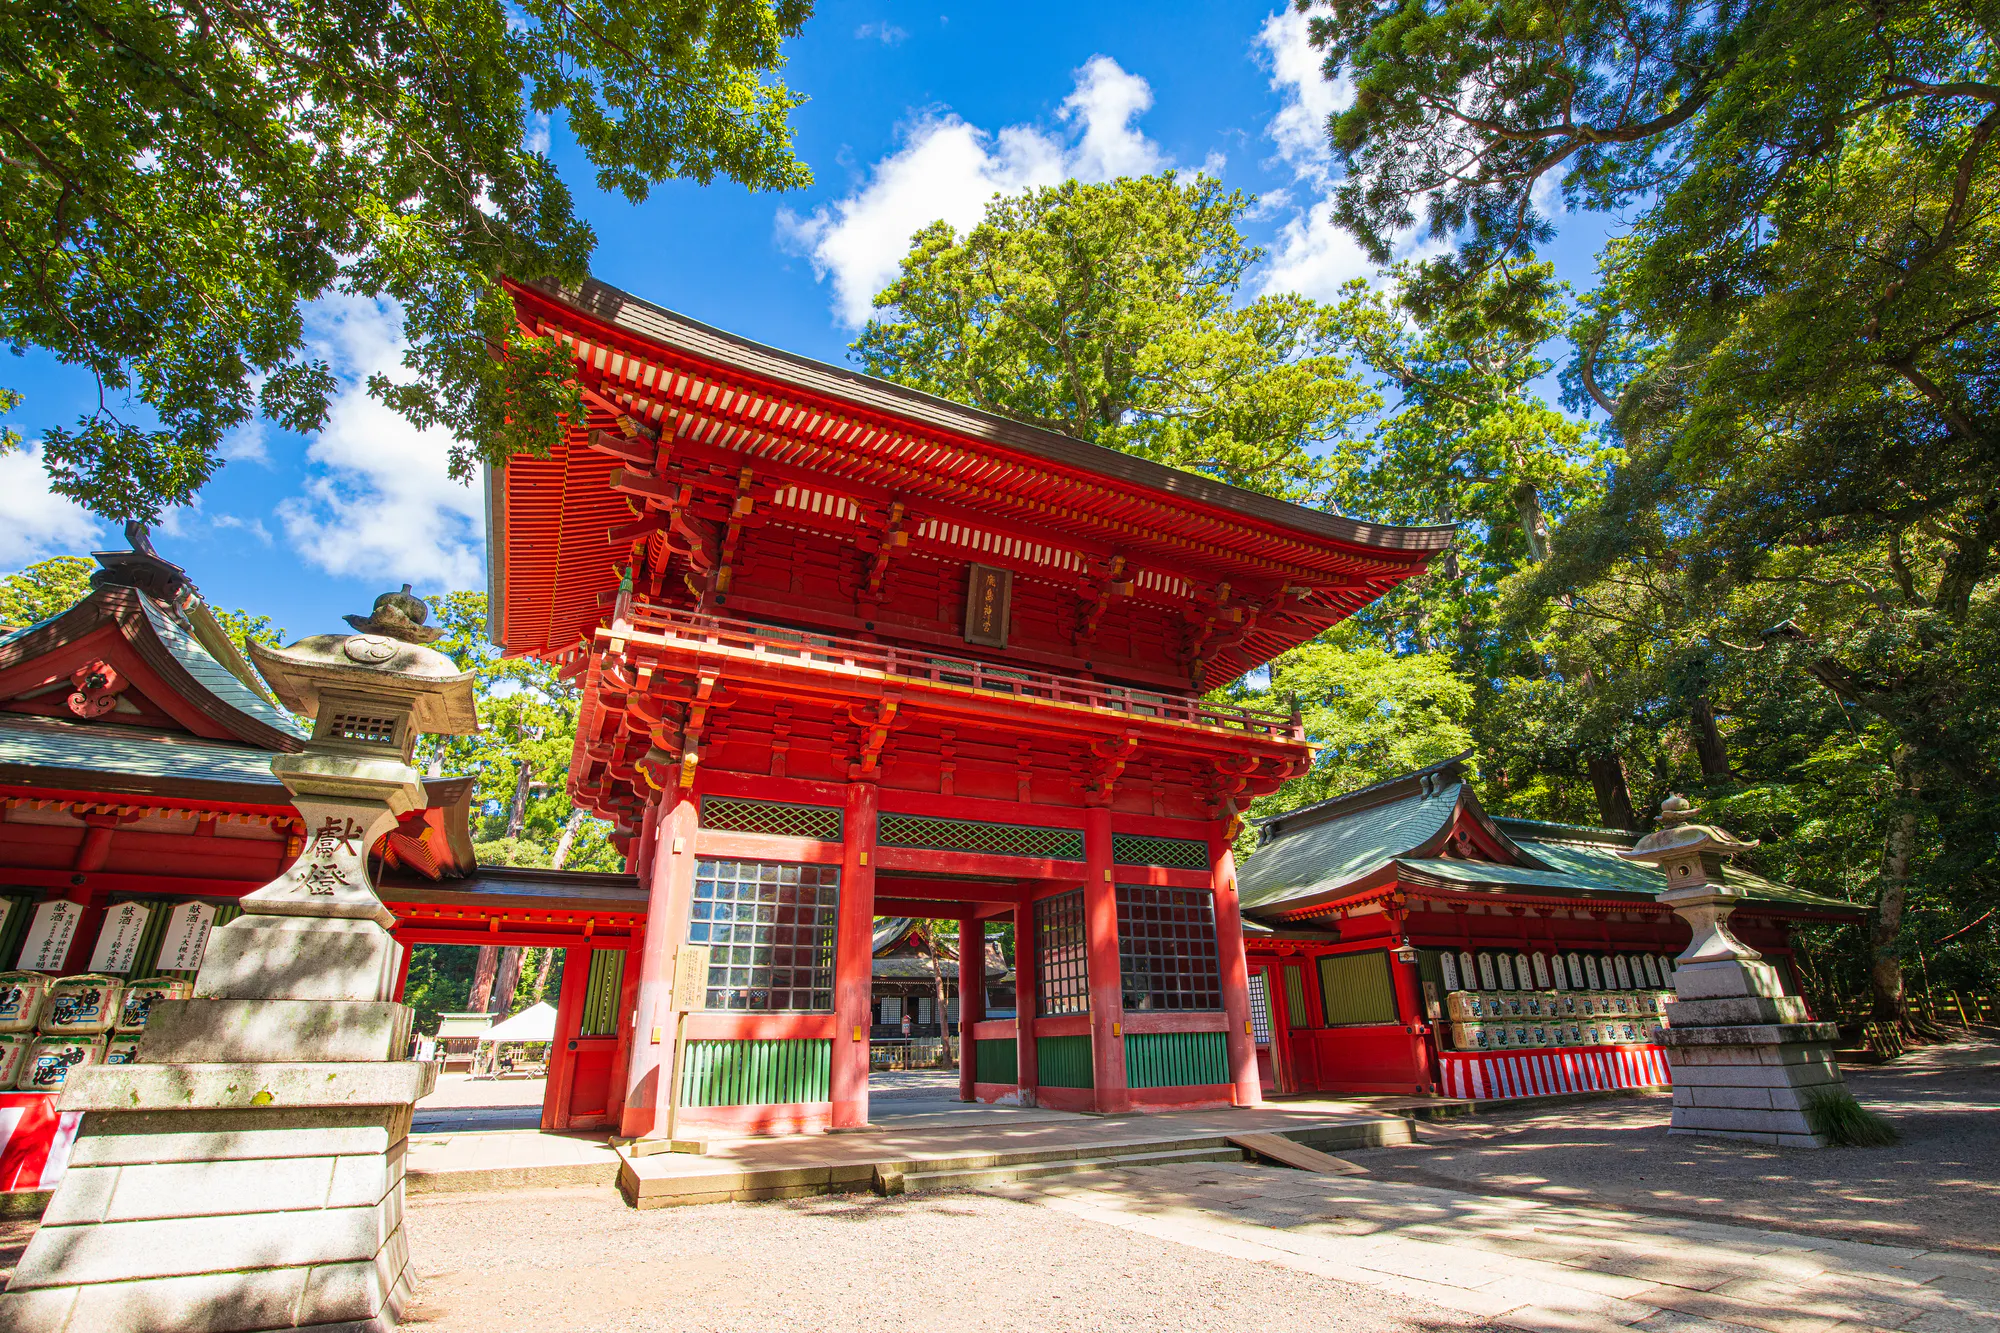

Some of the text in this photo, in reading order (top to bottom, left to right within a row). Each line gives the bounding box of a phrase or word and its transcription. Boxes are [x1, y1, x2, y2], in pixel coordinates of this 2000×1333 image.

[982, 574, 997, 633] 鹿島神宮
[50, 902, 69, 922] 献酒
[118, 905, 136, 925] 献酒
[185, 904, 203, 923] 献酒
